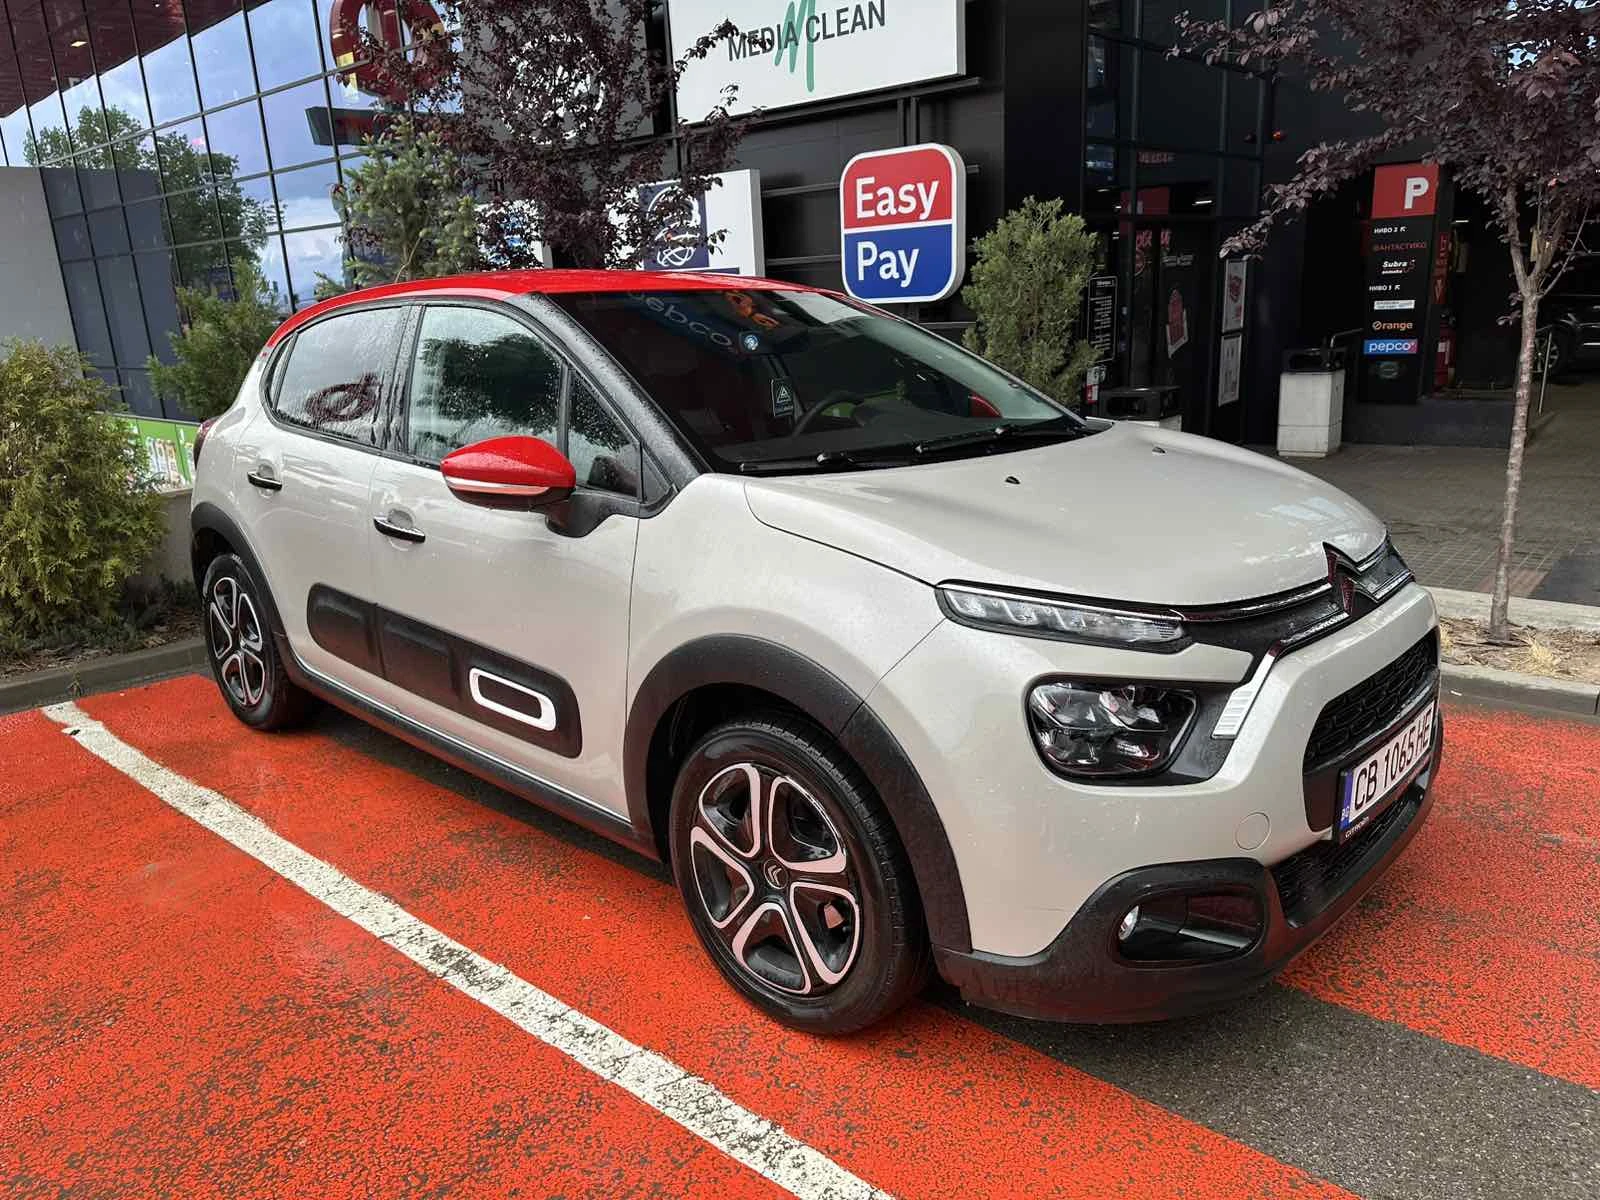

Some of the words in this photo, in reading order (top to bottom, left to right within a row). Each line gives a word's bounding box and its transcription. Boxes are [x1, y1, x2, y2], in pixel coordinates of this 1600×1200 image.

[728, 20, 799, 61] MEDIA
[805, 0, 886, 44] CLEAN
[856, 176, 940, 220] Easy
[1403, 177, 1429, 209] P
[857, 241, 920, 288] Pay
[1382, 260, 1407, 268] Subra
[1368, 341, 1410, 353] pepco
[1354, 759, 1378, 810] CB
[1383, 726, 1416, 788] 1065
[1414, 709, 1432, 756] HE
